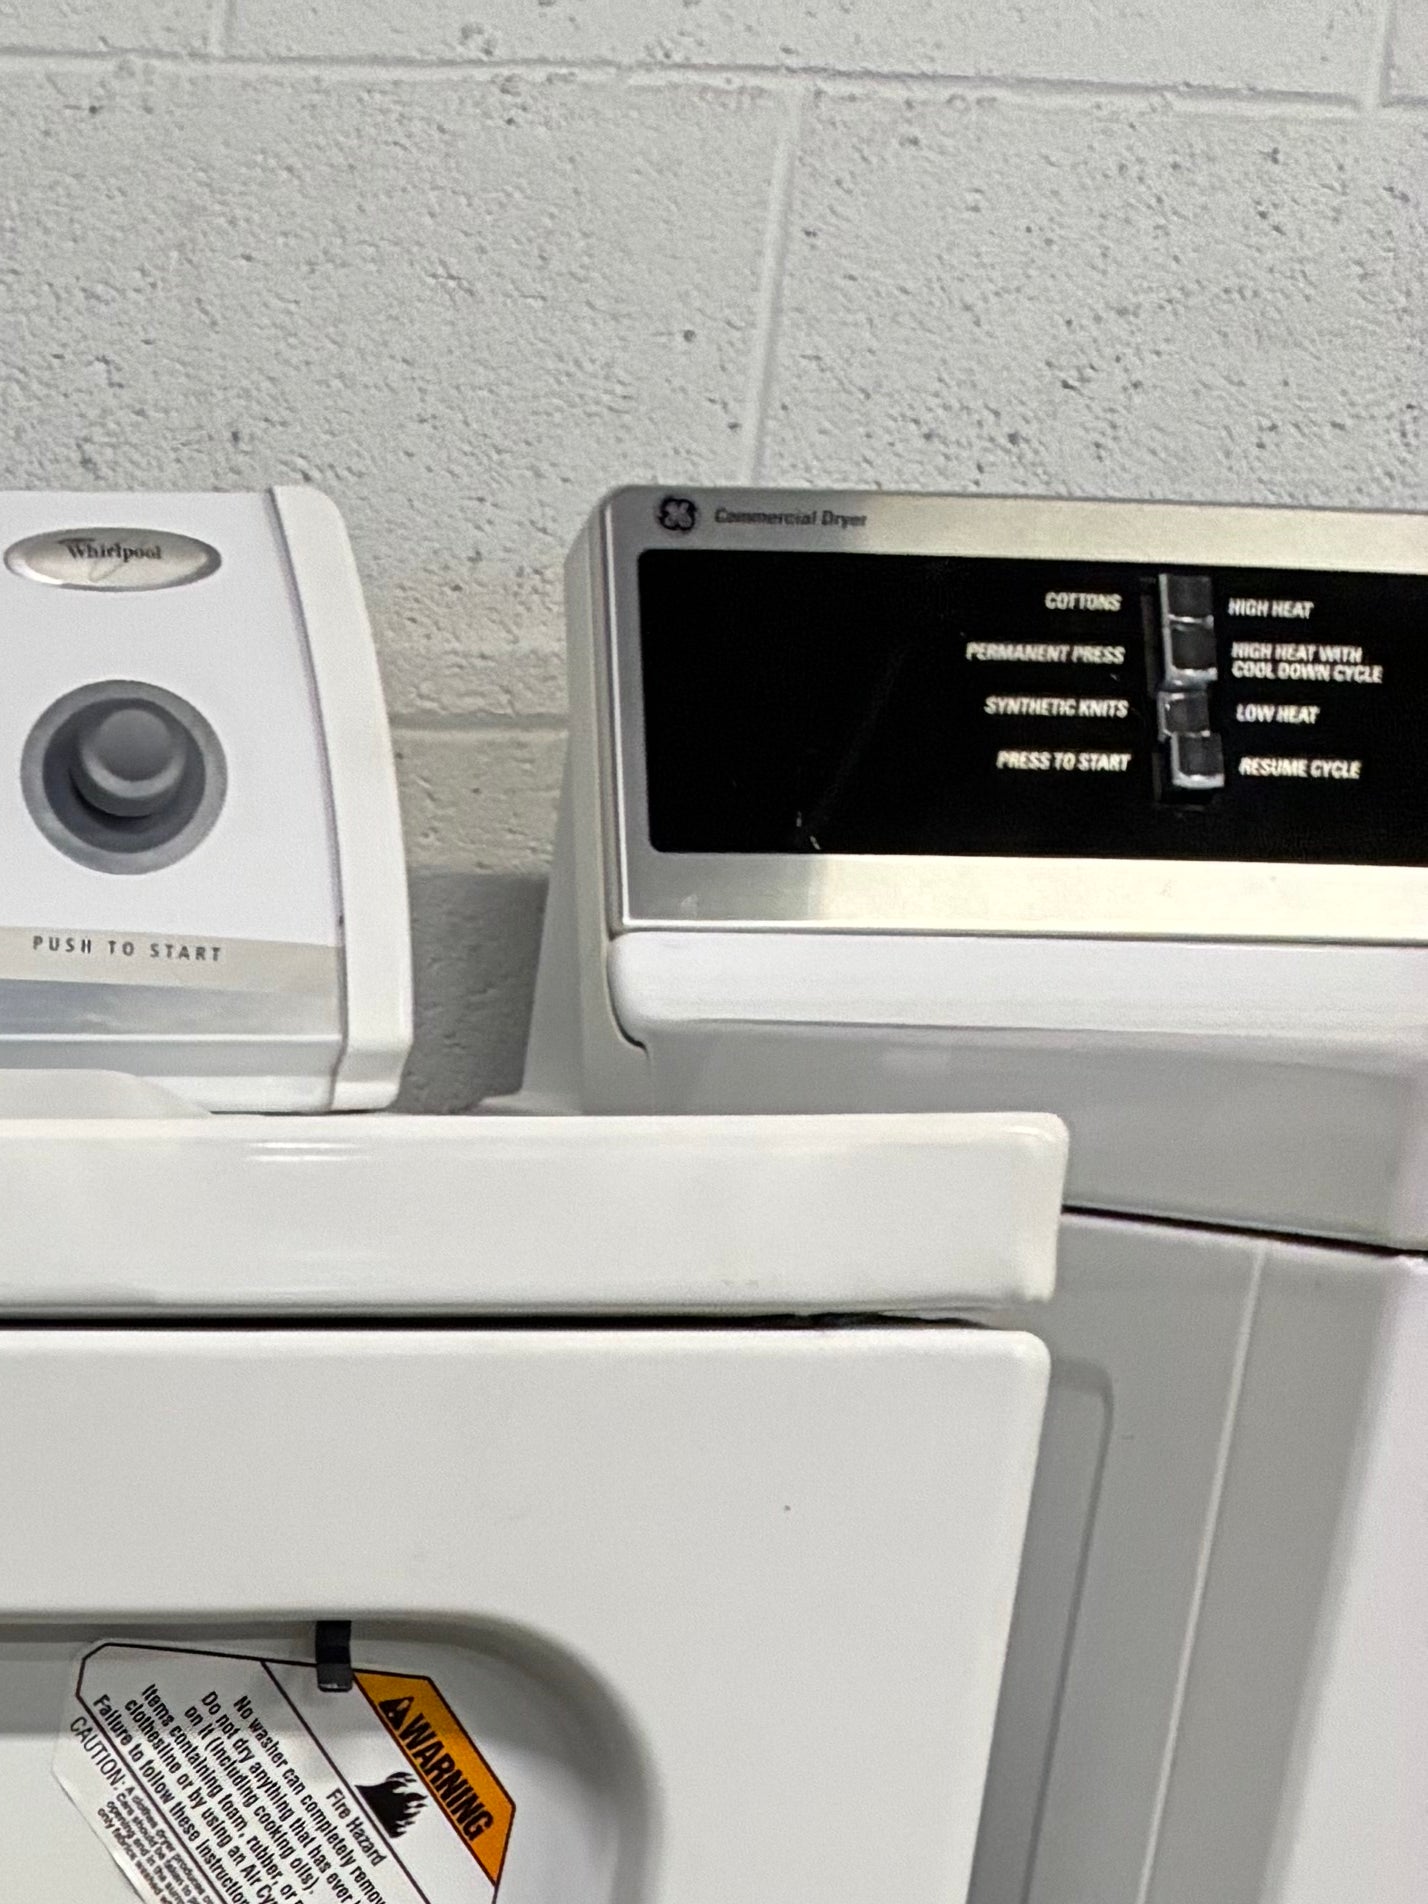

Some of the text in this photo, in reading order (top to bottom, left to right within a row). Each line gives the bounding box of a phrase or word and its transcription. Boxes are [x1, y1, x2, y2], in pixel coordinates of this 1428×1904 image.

[714, 507, 817, 525] Commercial
[821, 510, 867, 529] Dryer
[58, 538, 162, 563] Whirlpool
[1045, 592, 1123, 612] COTTONS
[1228, 597, 1315, 619] HIGH HEAT
[966, 642, 1126, 665] PERMANENT PRESS
[1231, 641, 1363, 663] HIGH HEAT WITH
[1231, 661, 1384, 684] COOL DOWN CYCLE
[984, 696, 1129, 719] SYNTHETIC KNITS
[1236, 703, 1320, 725] LOW HEAT
[996, 750, 1132, 772] PRESS TO START
[1238, 756, 1362, 780] RESUME CYCLE
[33, 935, 221, 961] PUSH TO START
[69, 1716, 126, 1791] CAUTION:
[233, 1695, 254, 1720] No
[247, 1717, 289, 1768] washer
[281, 1767, 306, 1796] can
[300, 1794, 357, 1868] completely
[398, 1713, 494, 1845] WARNING
[184, 1705, 320, 1895] on it (including cooking oils).
[325, 1787, 388, 1867] Fire Hazard
